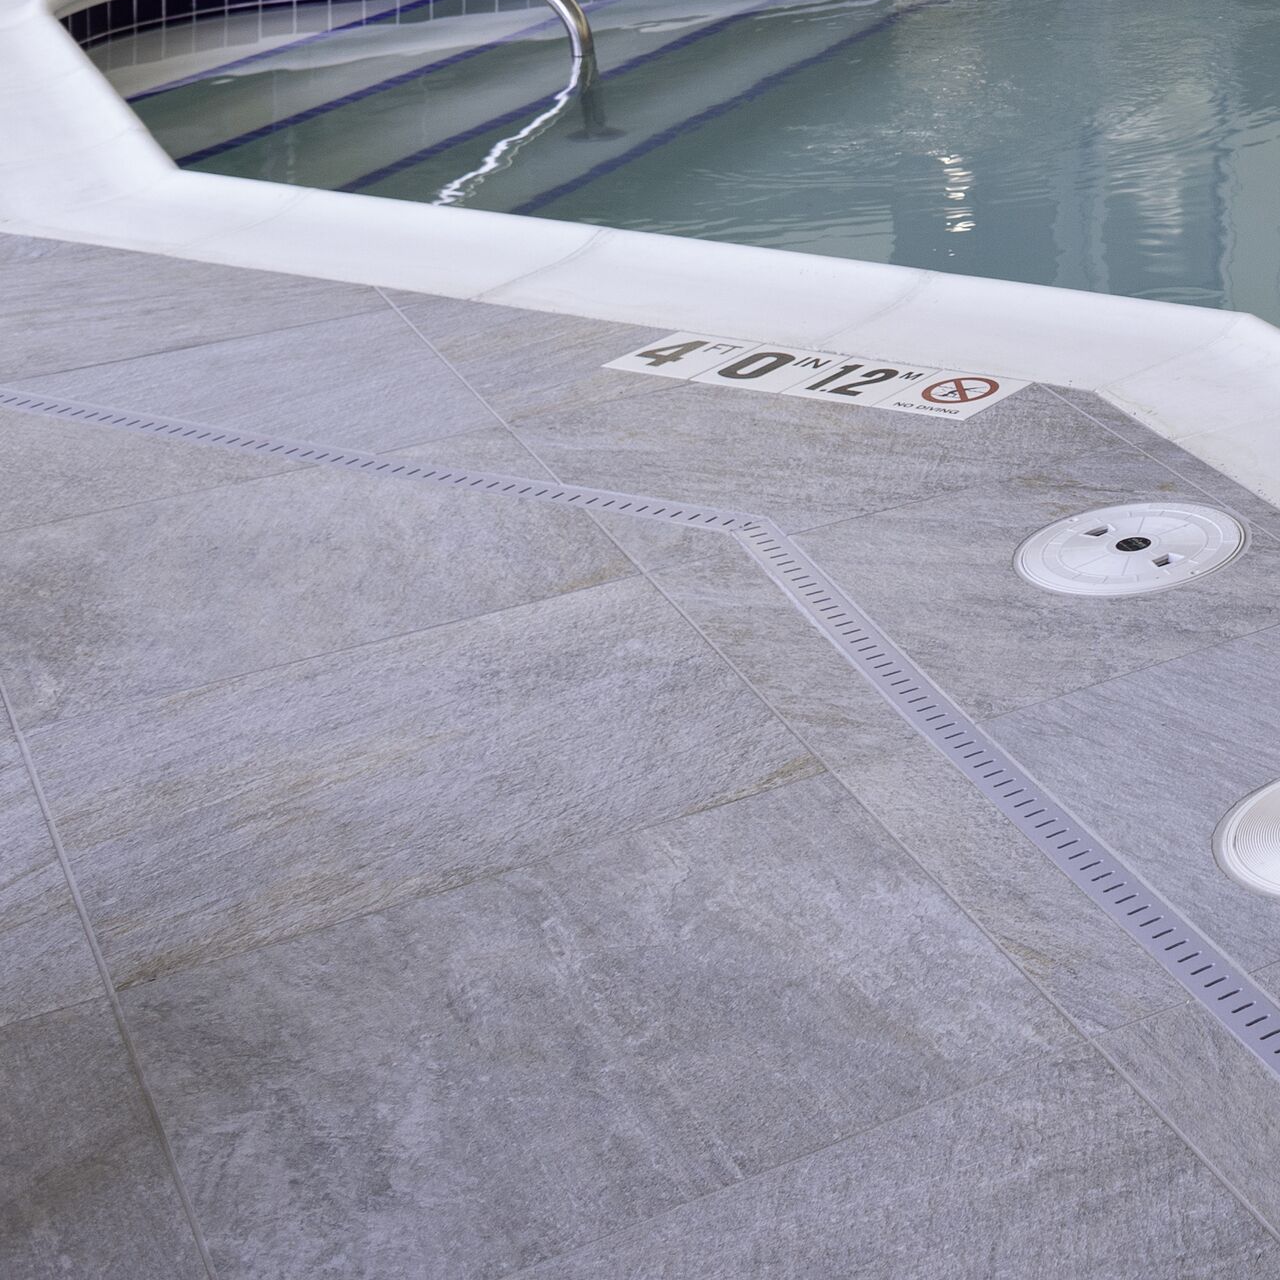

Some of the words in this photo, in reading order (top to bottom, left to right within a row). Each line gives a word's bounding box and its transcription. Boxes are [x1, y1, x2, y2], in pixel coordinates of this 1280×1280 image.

[635, 340, 710, 367] 4
[702, 344, 744, 356] FT
[718, 352, 796, 379] 0
[792, 357, 832, 368] IN
[805, 364, 899, 396] 1.2
[900, 372, 924, 381] M
[916, 404, 959, 415] DIVING
